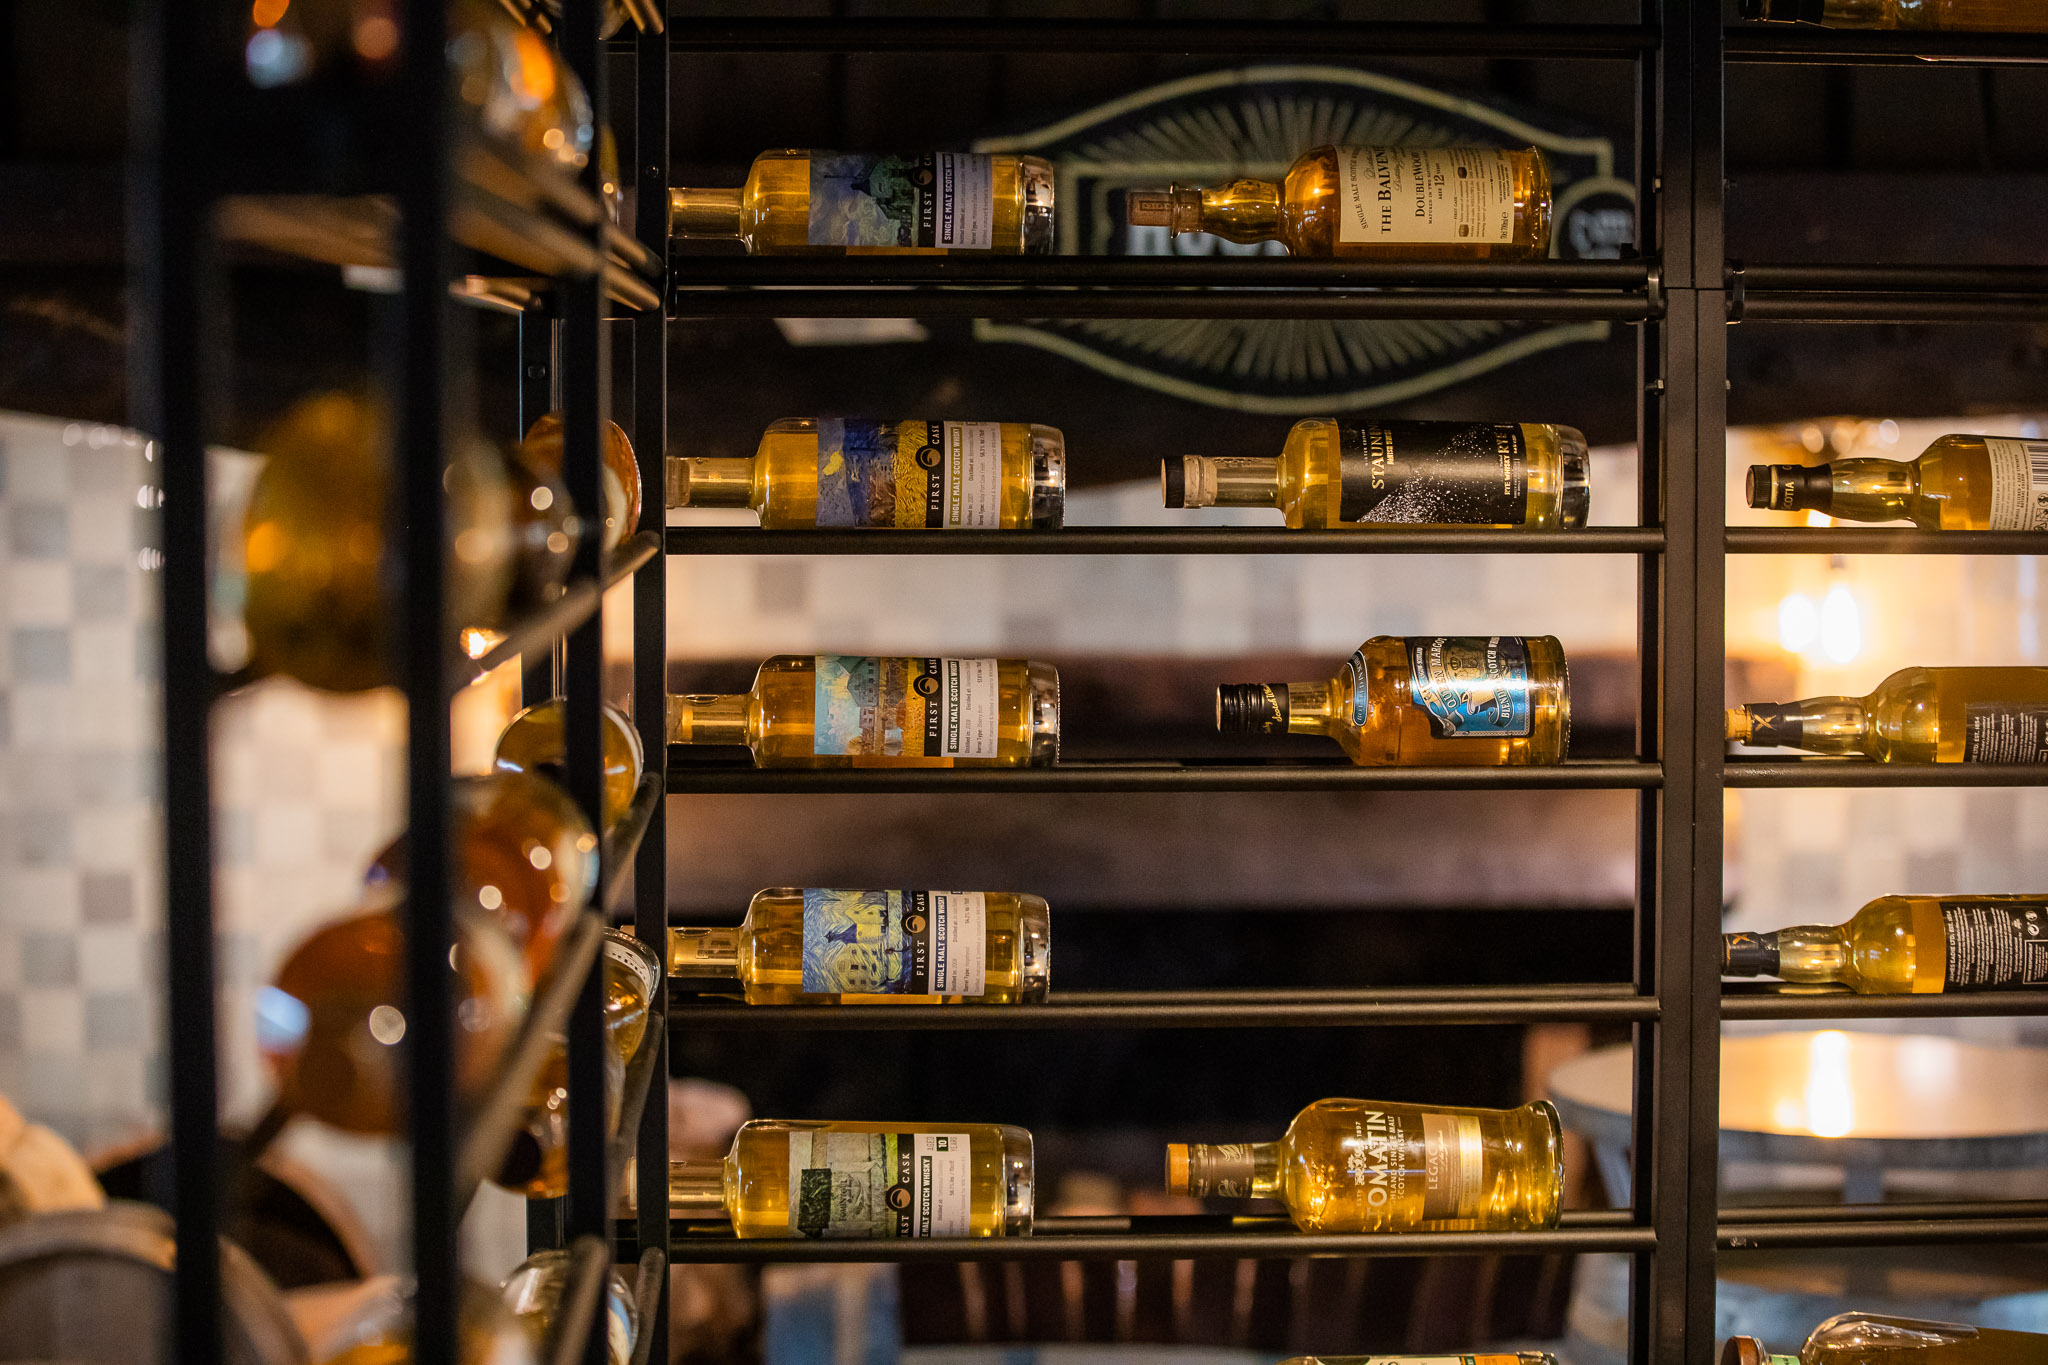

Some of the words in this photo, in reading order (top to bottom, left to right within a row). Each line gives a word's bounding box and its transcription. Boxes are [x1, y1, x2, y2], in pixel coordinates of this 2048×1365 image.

[1374, 146, 1391, 202] BALVENI
[1433, 174, 1445, 186] 12
[1351, 183, 1360, 202] MALT
[923, 191, 932, 228] FIRST
[1355, 203, 1369, 230] SINGLE
[1381, 205, 1391, 235] THE
[944, 214, 952, 241] SINGLE
[952, 427, 960, 448] WHISKY
[1496, 433, 1509, 454] RYE
[1369, 424, 1385, 490] STAUNIN
[931, 473, 940, 510] FIRST
[952, 476, 960, 496] MALT
[951, 497, 960, 522] SINGLE
[1487, 650, 1499, 678] SCOTCH
[950, 677, 958, 702] SCOTCH
[1433, 670, 1457, 709] QUN
[950, 702, 958, 723] MALT
[1267, 698, 1283, 722] Scotch
[1495, 688, 1510, 719] BLEND
[929, 701, 938, 737] FIRST
[950, 723, 958, 750] SINGLE
[916, 940, 925, 976] FIRST
[937, 942, 945, 962] MALT
[937, 963, 945, 989] SINGLE
[1387, 1115, 1396, 1134] MALT
[926, 1136, 935, 1152] AGED
[950, 1136, 958, 1152] YEARS
[1397, 1129, 1405, 1161] WHISKY
[902, 1153, 910, 1184] CASK
[922, 1158, 930, 1187] WHISKY
[1364, 1110, 1389, 1216] TOMATIN
[1428, 1142, 1439, 1190] LEGAC
[1397, 1164, 1405, 1200] SCOTCH
[922, 1188, 930, 1216] SCOTCH
[922, 1216, 930, 1233] MALT
